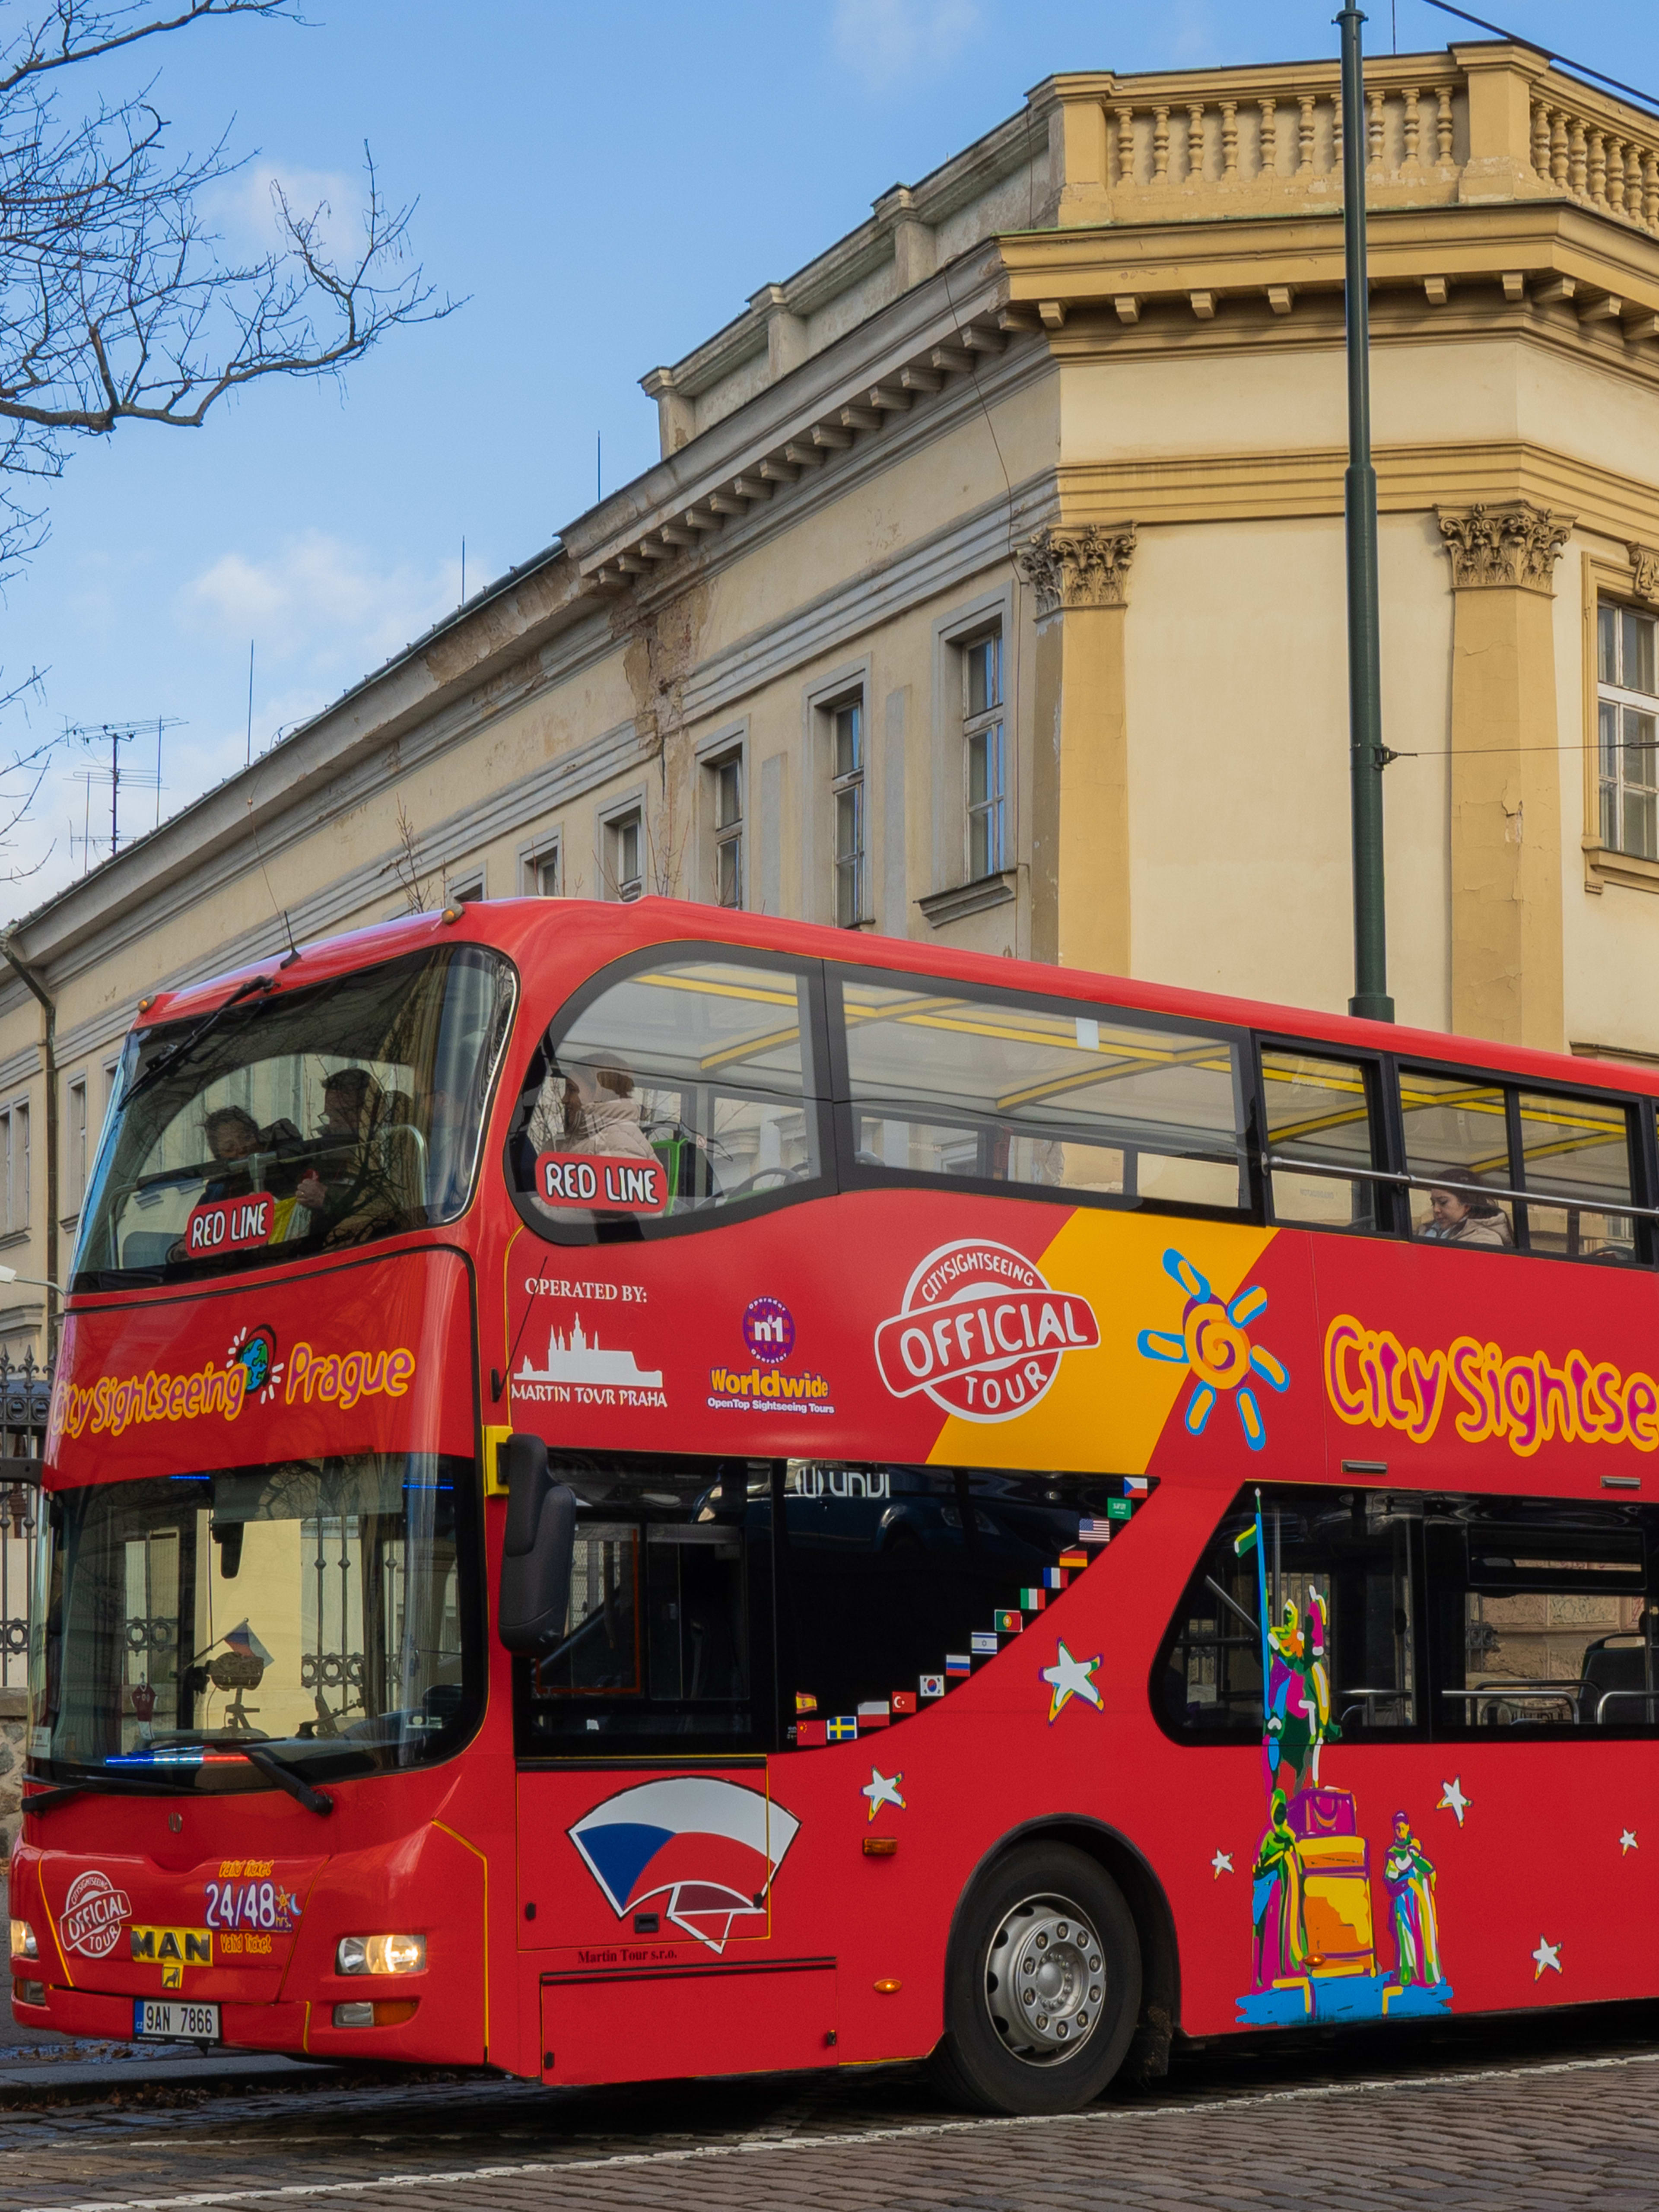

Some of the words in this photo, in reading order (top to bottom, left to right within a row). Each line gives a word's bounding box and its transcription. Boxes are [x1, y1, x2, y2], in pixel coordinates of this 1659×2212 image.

[545, 1162, 597, 1199] RED
[605, 1166, 659, 1204] LINE
[191, 1210, 226, 1248] RED
[231, 1201, 268, 1240] LINE
[524, 1277, 618, 1300] OPERATED
[621, 1285, 647, 1303] BY:
[921, 1252, 1034, 1303] CITYSIGHTSEEING
[900, 1301, 1088, 1377] OFFICIAL
[286, 1342, 415, 1409] Prague
[711, 1368, 828, 1398] Worldwide
[965, 1361, 1048, 1409] TOUR
[511, 1383, 570, 1402] MARTIN
[574, 1387, 616, 1405] TOUR
[618, 1389, 668, 1408] PRAHA
[707, 1397, 750, 1411] OpenTop
[752, 1399, 807, 1414] Sightseeing
[808, 1403, 835, 1414] Tours
[1448, 1336, 1659, 1457] Sightse
[71, 1877, 108, 1905] CITYSIGHTSEEING
[206, 1883, 275, 1928] 24/48
[68, 1894, 127, 1941] OFFICIAL
[89, 1925, 118, 1951] TOUR
[130, 1931, 211, 1961] MAN
[220, 1933, 243, 1953] Valid
[244, 1933, 272, 1954] Ticket
[578, 1950, 617, 1964] Martin
[620, 1949, 648, 1961] Tour
[651, 1949, 677, 1960] s.r.o.
[146, 2005, 170, 2031] 9AN
[181, 2007, 213, 2034] 7866
